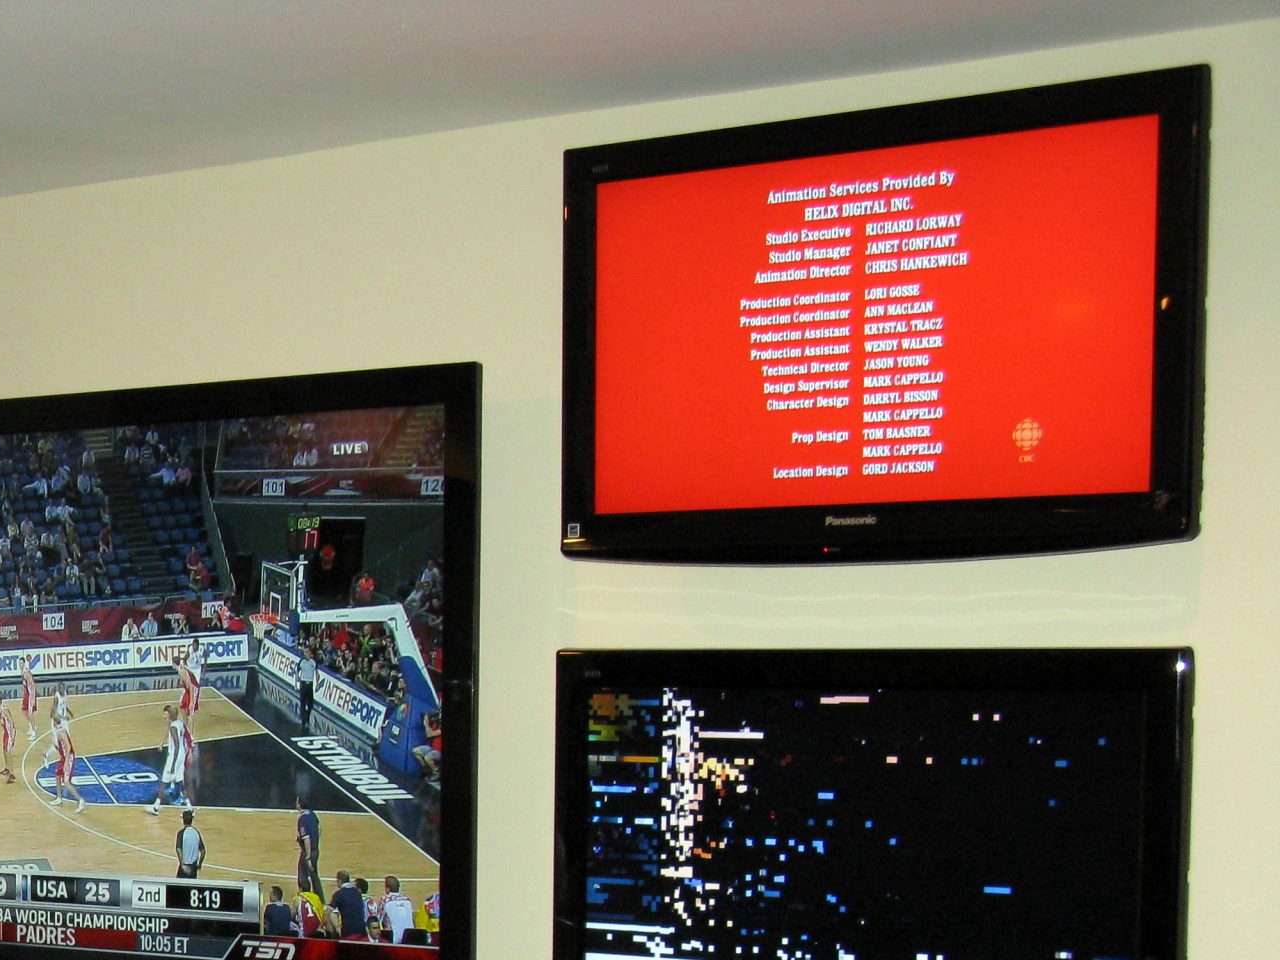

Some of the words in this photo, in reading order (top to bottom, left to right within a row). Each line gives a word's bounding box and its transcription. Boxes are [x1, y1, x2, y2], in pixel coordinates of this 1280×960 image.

[767, 186, 827, 204] Animation
[829, 180, 879, 198] Services
[881, 174, 937, 191] Provided
[939, 171, 955, 187] By
[804, 204, 839, 221] HELIX
[841, 200, 888, 217] DIGITAL
[890, 197, 914, 212] INC.
[765, 231, 799, 246] Studio
[800, 226, 852, 242] Executive
[865, 219, 913, 236] RICHARD
[915, 214, 962, 231] LORWAY
[768, 249, 801, 264] Studio
[803, 246, 852, 263] Manager
[865, 239, 900, 256] JANET
[901, 234, 958, 252] CONFIANT
[754, 268, 807, 284] Animation
[809, 264, 851, 280] Director
[865, 258, 898, 275] CHRIS
[900, 253, 968, 272] HANKEWICH
[740, 297, 791, 310] Production
[792, 291, 851, 306] Coordinator
[864, 288, 887, 301] LORI
[888, 284, 920, 298] GOSSE
[740, 314, 791, 328] Production
[792, 309, 851, 323] Coordinator
[864, 305, 885, 318] ANN
[886, 301, 933, 316] MACLEAN
[750, 331, 802, 344] Production
[803, 326, 850, 340] Assistant
[864, 322, 908, 336] KRYSTAL
[909, 318, 943, 331] TRACZ
[750, 348, 802, 361] Production
[803, 344, 850, 357] Assistant
[864, 340, 898, 353] WENDY
[901, 336, 943, 350] WALKER
[762, 364, 808, 377] Technical
[810, 361, 850, 373] Director
[863, 358, 894, 371] JASON
[896, 355, 929, 368] YOUNG
[763, 381, 796, 396] Design
[797, 378, 850, 393] Supervisor
[863, 375, 891, 388] MARK
[893, 372, 944, 387] CAPPELLO
[766, 397, 815, 411] Character
[816, 395, 850, 409] Design
[863, 392, 901, 406] DARRYL
[903, 389, 939, 403] BISSON
[863, 410, 891, 423] MARK
[893, 407, 943, 421] CAPPELLO
[791, 431, 814, 445] Prop
[815, 429, 849, 444] Design
[862, 428, 884, 441] TOM
[885, 425, 931, 439] BAASNER
[332, 444, 363, 455] LIVE
[862, 446, 891, 458] MARK
[893, 443, 942, 456] CAPPELLO
[773, 466, 814, 479] Location
[815, 464, 849, 478] Design
[862, 462, 888, 475] GORD
[889, 460, 935, 475] JACKSON
[264, 481, 284, 494] 101
[825, 515, 877, 526] Panasonic
[44, 616, 64, 629] 104
[43, 648, 130, 670] INTERSPORT
[323, 678, 383, 730] INTERSPORT
[36, 881, 69, 898] USA
[84, 882, 111, 903] 25
[137, 887, 161, 904] 2nd
[190, 890, 221, 909] 8:19
[15, 908, 62, 926] WORLD
[66, 911, 169, 932] CHAMPIONSHIP
[16, 925, 77, 946] PADRES
[139, 934, 171, 953] 10:05
[174, 936, 190, 954] ET
[241, 940, 296, 960] TSN
